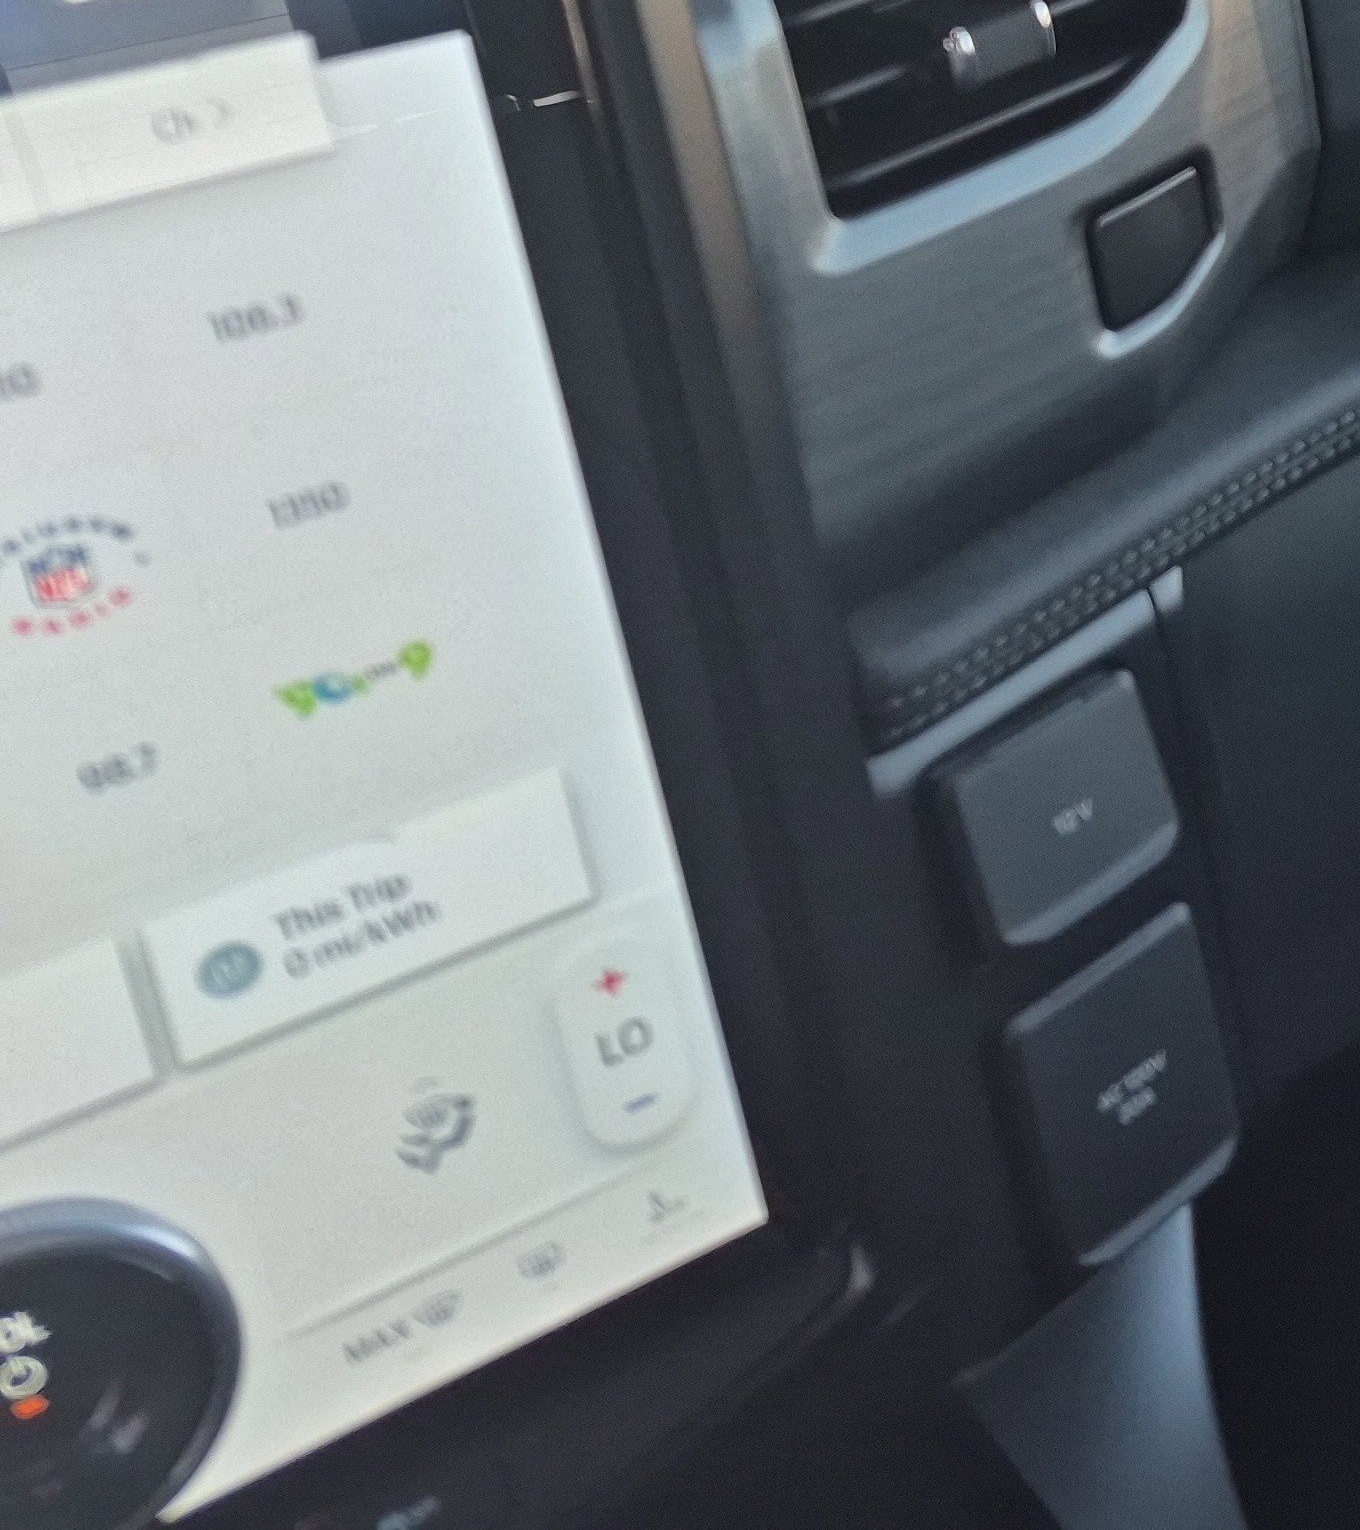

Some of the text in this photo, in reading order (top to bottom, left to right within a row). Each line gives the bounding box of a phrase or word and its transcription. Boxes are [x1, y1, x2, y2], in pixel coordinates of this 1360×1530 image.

[272, 873, 412, 942] This Trip
[594, 1016, 654, 1068] LO
